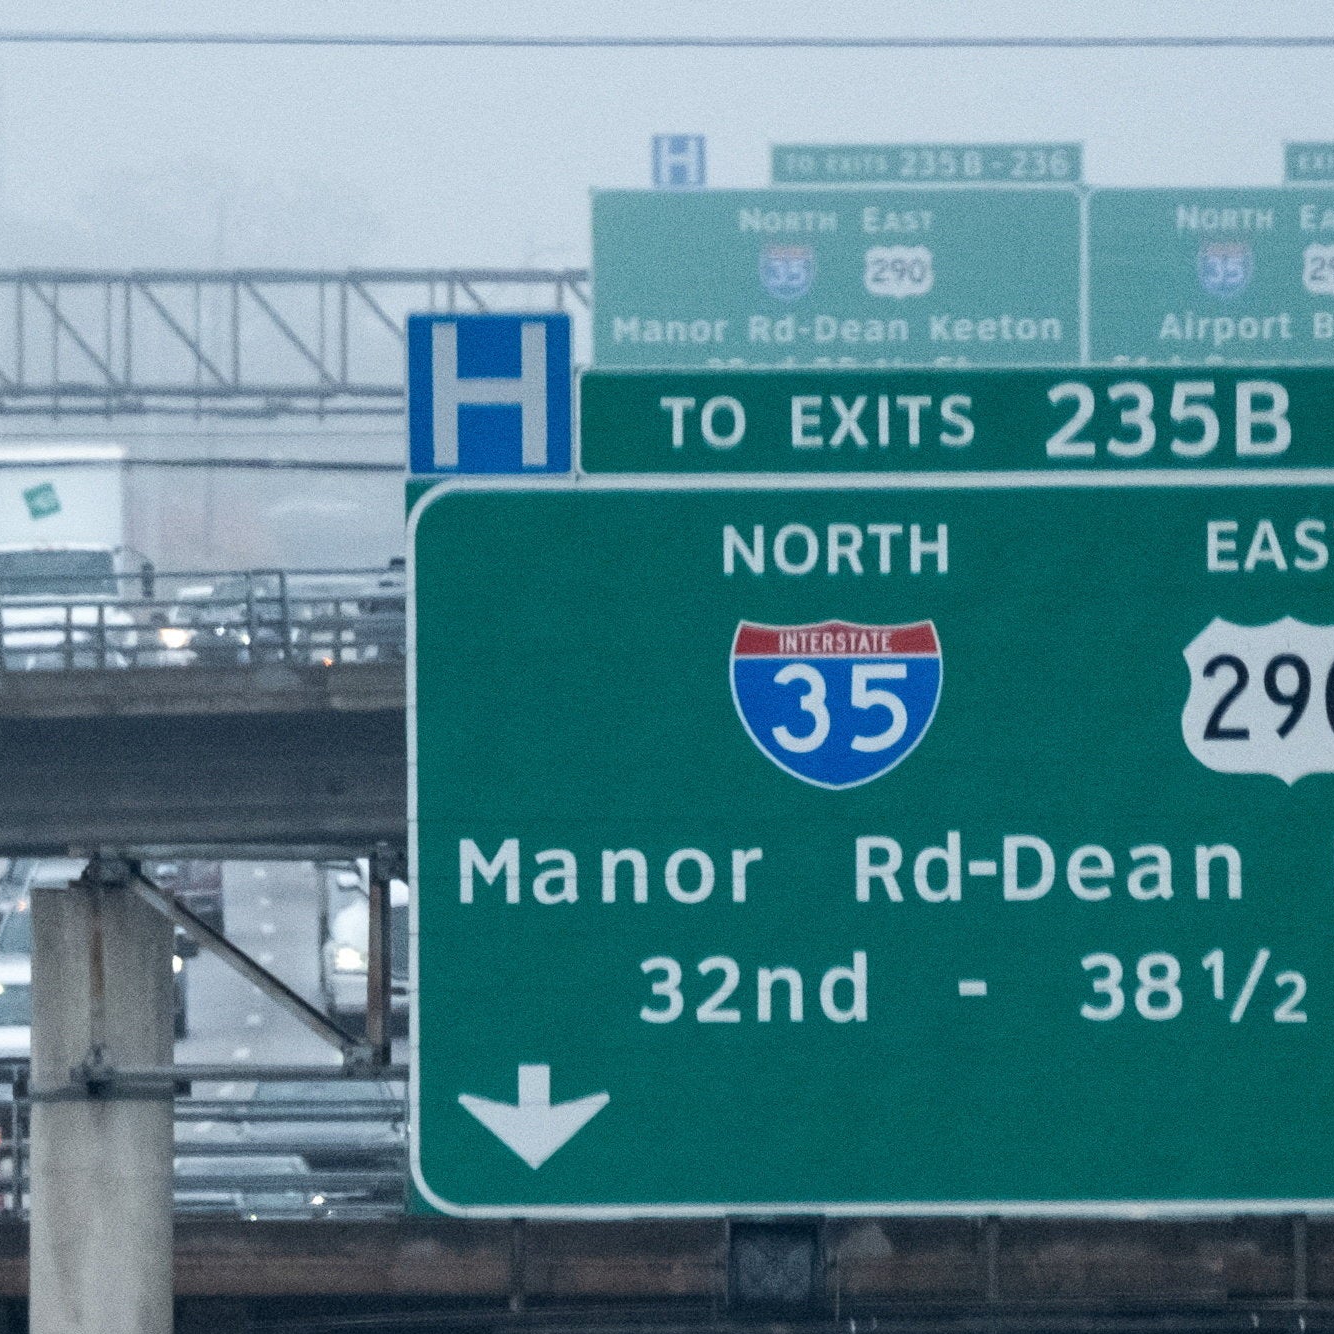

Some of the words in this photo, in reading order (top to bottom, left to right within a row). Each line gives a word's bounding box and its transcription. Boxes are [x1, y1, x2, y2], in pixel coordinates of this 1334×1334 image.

[657, 137, 702, 185] H
[826, 155, 887, 172] EXITS
[901, 151, 981, 176] 235B
[1012, 150, 1067, 176] 236
[740, 208, 836, 232] NORTH
[863, 207, 931, 233] EAST
[1177, 205, 1272, 229] NORTH
[769, 260, 807, 287] 35
[867, 259, 929, 284] 290
[1208, 257, 1244, 284] 35
[613, 317, 727, 342] Manor
[749, 315, 908, 342] Rd-Dean
[930, 315, 1061, 341] Keeton
[1160, 312, 1291, 346] Airport
[432, 325, 547, 466] H
[661, 397, 745, 447] TO
[792, 395, 974, 447] EXITS
[1046, 381, 1291, 457] 235B
[724, 524, 948, 574] NORTH
[779, 631, 891, 653] INTERSTATE
[773, 664, 907, 752] 35
[460, 839, 762, 904] Manor
[856, 831, 1241, 902] Rd-Dean
[641, 951, 867, 1023] 32nd
